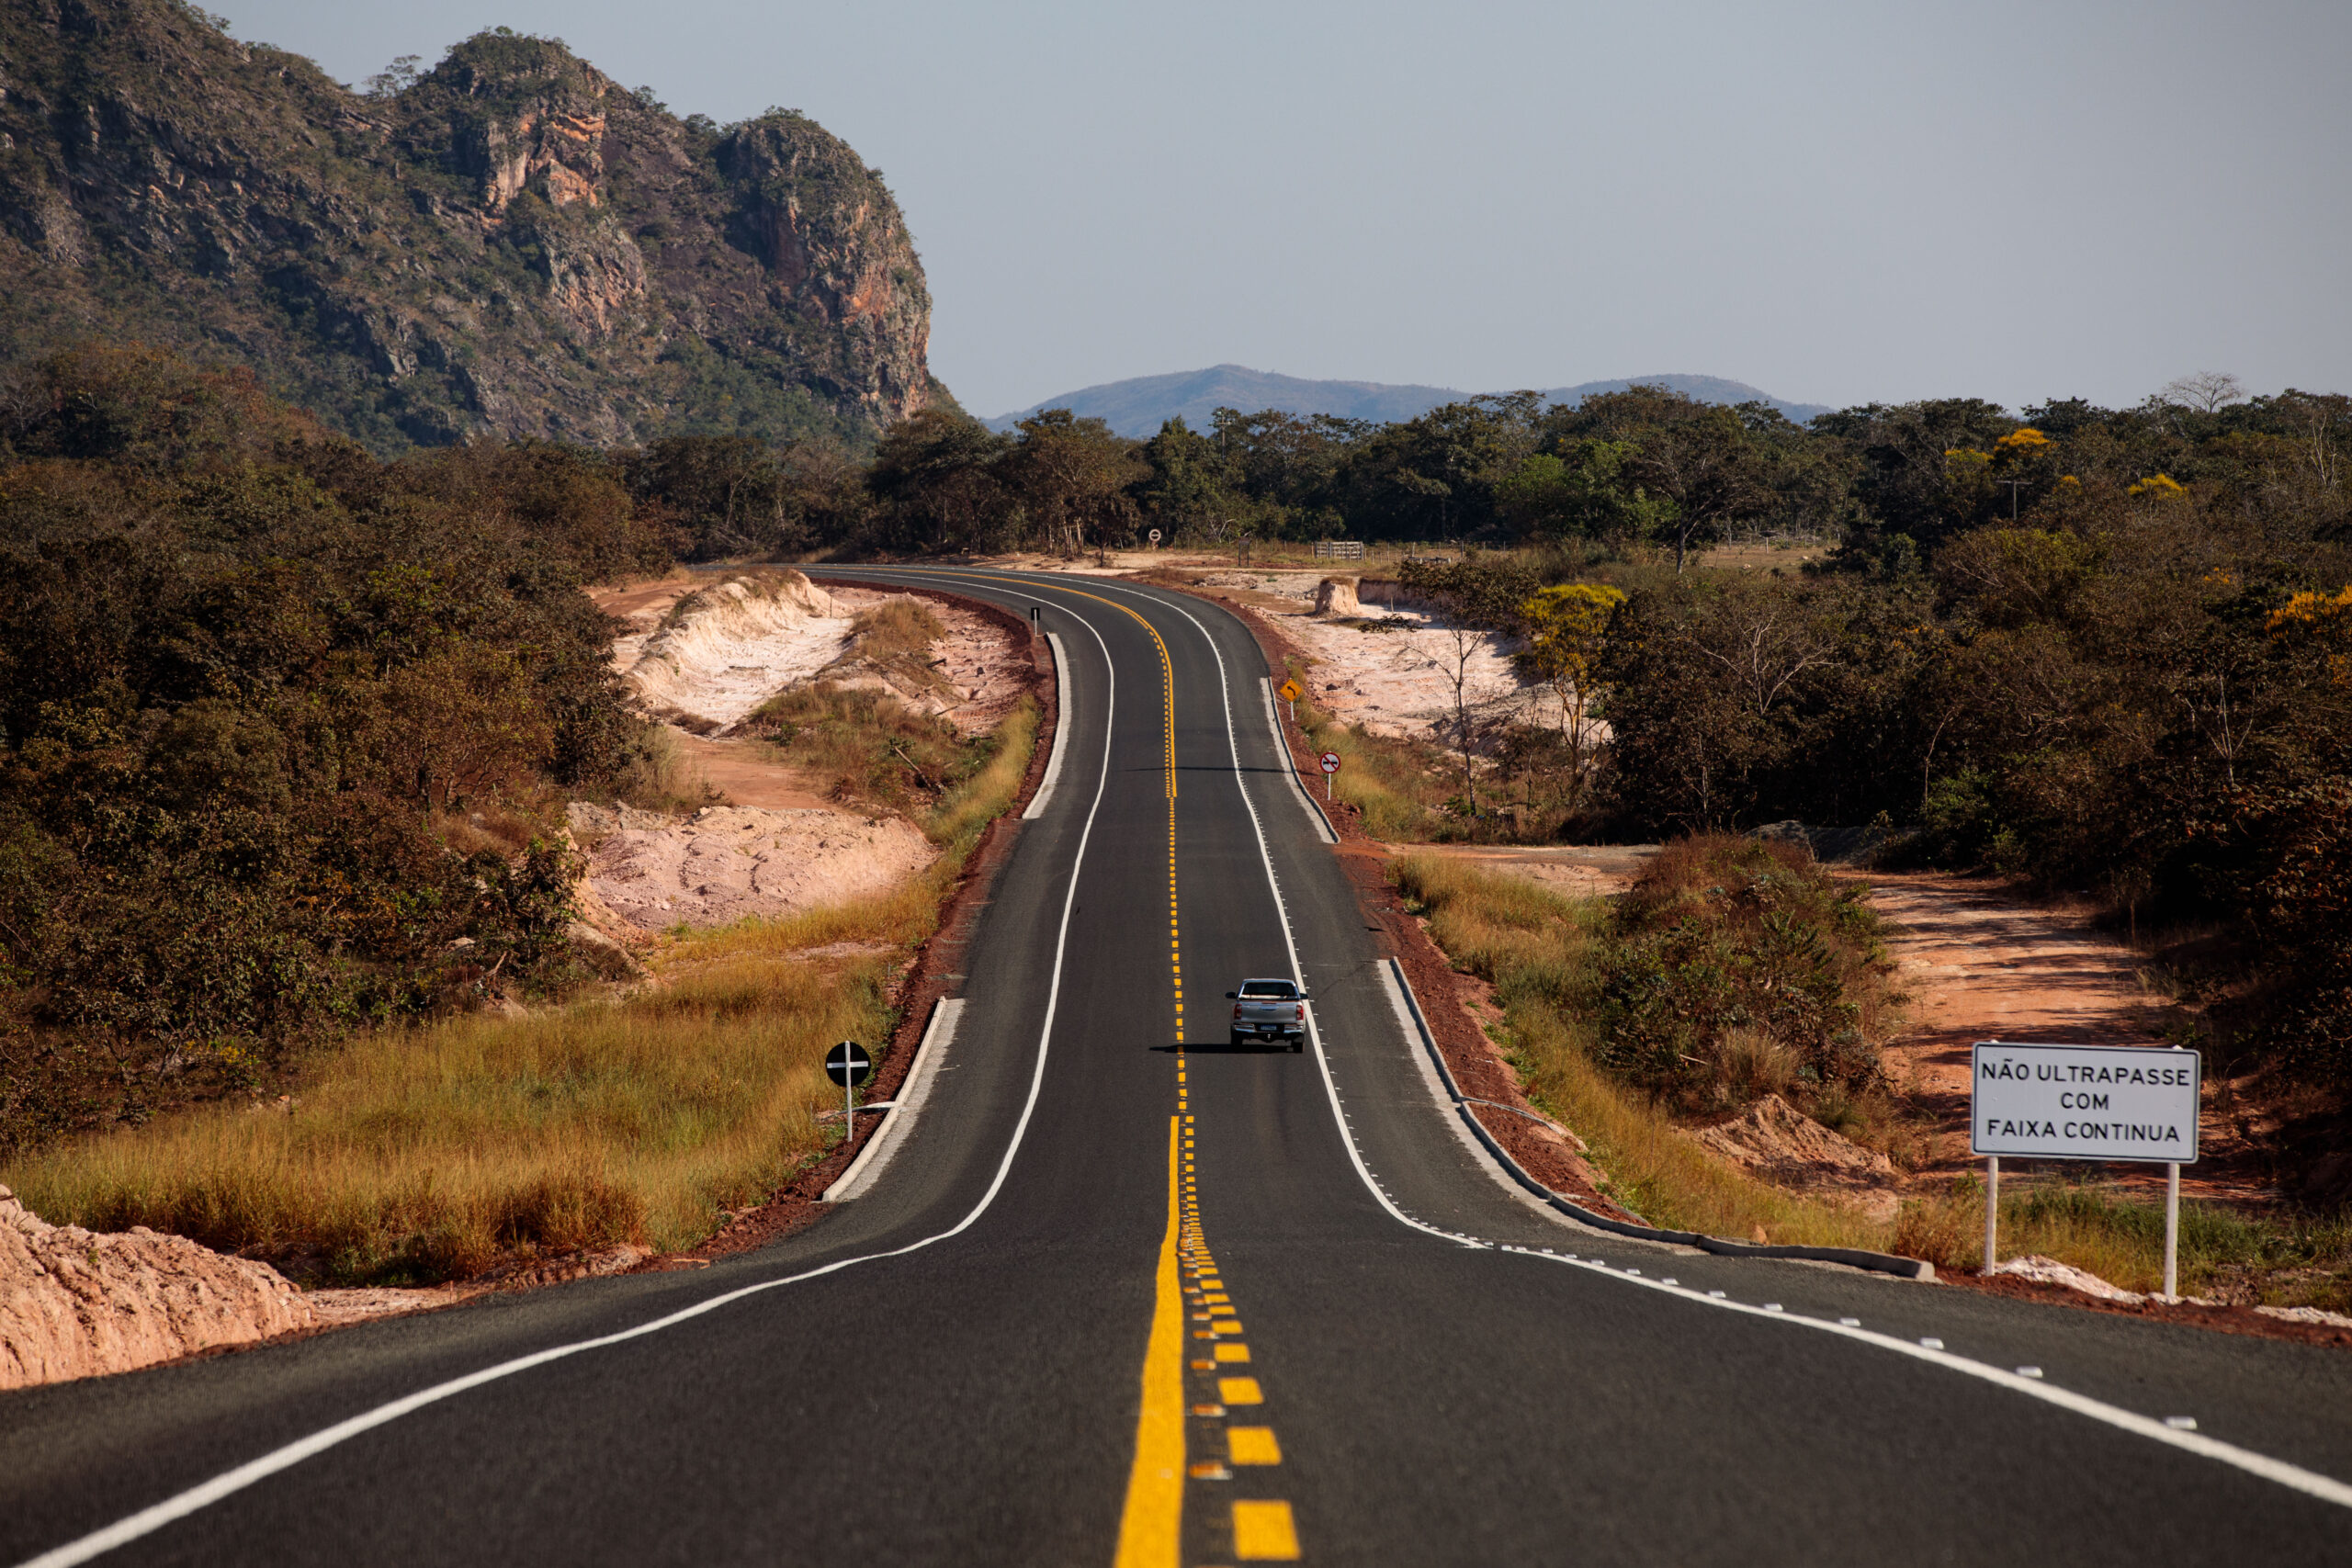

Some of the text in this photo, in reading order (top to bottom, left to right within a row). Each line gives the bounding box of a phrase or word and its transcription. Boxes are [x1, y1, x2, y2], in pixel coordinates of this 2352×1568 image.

[1982, 1058, 2190, 1086] NÃO ULTRAPASSE
[2061, 1092, 2109, 1111] COM
[1988, 1119, 2180, 1142] FAIXA CONTINUA
